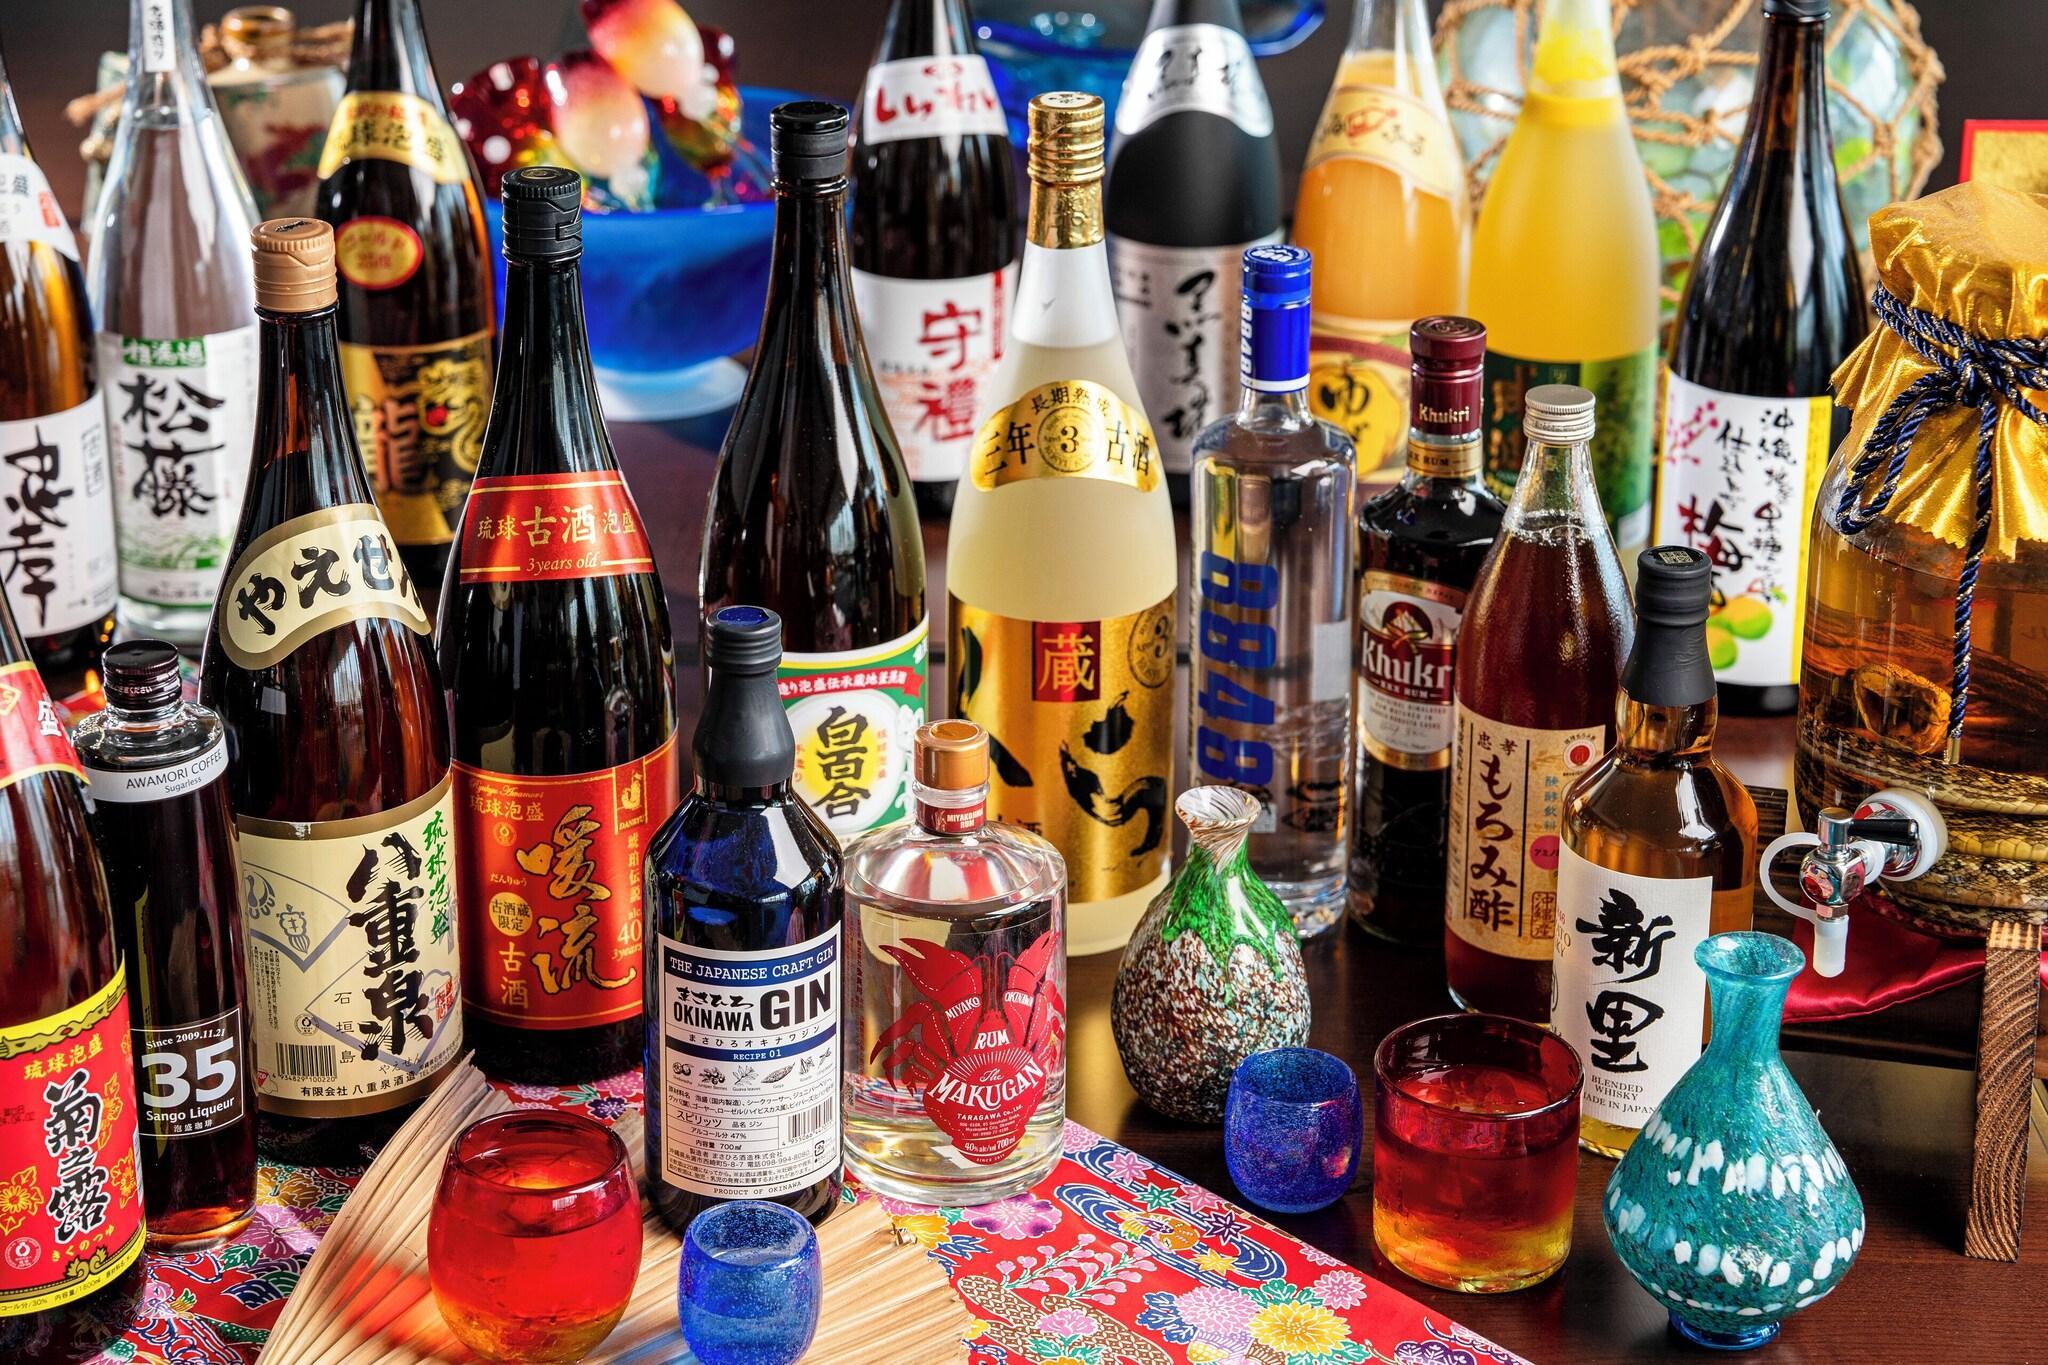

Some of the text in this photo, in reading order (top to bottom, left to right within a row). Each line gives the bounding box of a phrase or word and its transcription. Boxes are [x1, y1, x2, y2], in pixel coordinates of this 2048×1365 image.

[1419, 403, 1470, 424] Khukri
[1060, 425, 1079, 453] 3
[1105, 420, 1151, 477] 古酒
[1423, 454, 1449, 466] RUM
[576, 552, 600, 570] old
[1038, 632, 1095, 693] 蔵
[1197, 550, 1280, 786] 8848
[1361, 630, 1453, 690] Khukr
[1405, 685, 1428, 699] RUM
[1477, 731, 1519, 755] 忠孝
[126, 750, 223, 790] AWAMORI COFFEE
[812, 705, 871, 819] 白百合
[164, 776, 202, 794] Sugarless
[469, 796, 545, 822] 琉球泡盛
[960, 818, 975, 829] RUM
[1469, 754, 1518, 932] もろみ酢
[492, 899, 530, 919] 古酒蔵
[498, 915, 525, 931] 限定
[617, 919, 642, 944] 40
[346, 831, 434, 1062] 八重泉
[499, 942, 529, 1009] 古酒
[670, 946, 834, 981] THE JAPANESE CRAFT GIN
[1576, 888, 1676, 1073] 新里
[675, 986, 754, 1010] まさひろ
[760, 971, 832, 1031] GIN
[945, 996, 981, 1021] MIYAKO
[335, 990, 356, 1065] 石垣島
[674, 1001, 755, 1032] OKINAWA
[146, 1028, 225, 1050] Since 2009.11.21
[689, 1025, 820, 1047] まさひろオキナワジン
[974, 1029, 1010, 1049] RUM
[24, 1033, 103, 1080] 琉球泡盛
[733, 1049, 781, 1060] RECIPE 01
[141, 1036, 237, 1109] 35
[980, 1067, 1004, 1083] The
[1592, 1075, 1644, 1093] BLENDED
[927, 1059, 1044, 1111] MAKUGAN
[1595, 1085, 1638, 1100] WHISKY
[146, 1097, 235, 1123] Sango Liqueur
[957, 1113, 1001, 1121] TARAGAWA
[1608, 1101, 1620, 1109] IN
[677, 1110, 722, 1127] スピリッツ
[749, 1120, 763, 1128] ジン
[690, 1127, 729, 1139] アルコール分
[696, 1139, 715, 1149] 内容量
[43, 1066, 111, 1245] 菊之露
[714, 1188, 748, 1196] PRODUCT
[768, 1182, 802, 1193] OKINAWA
